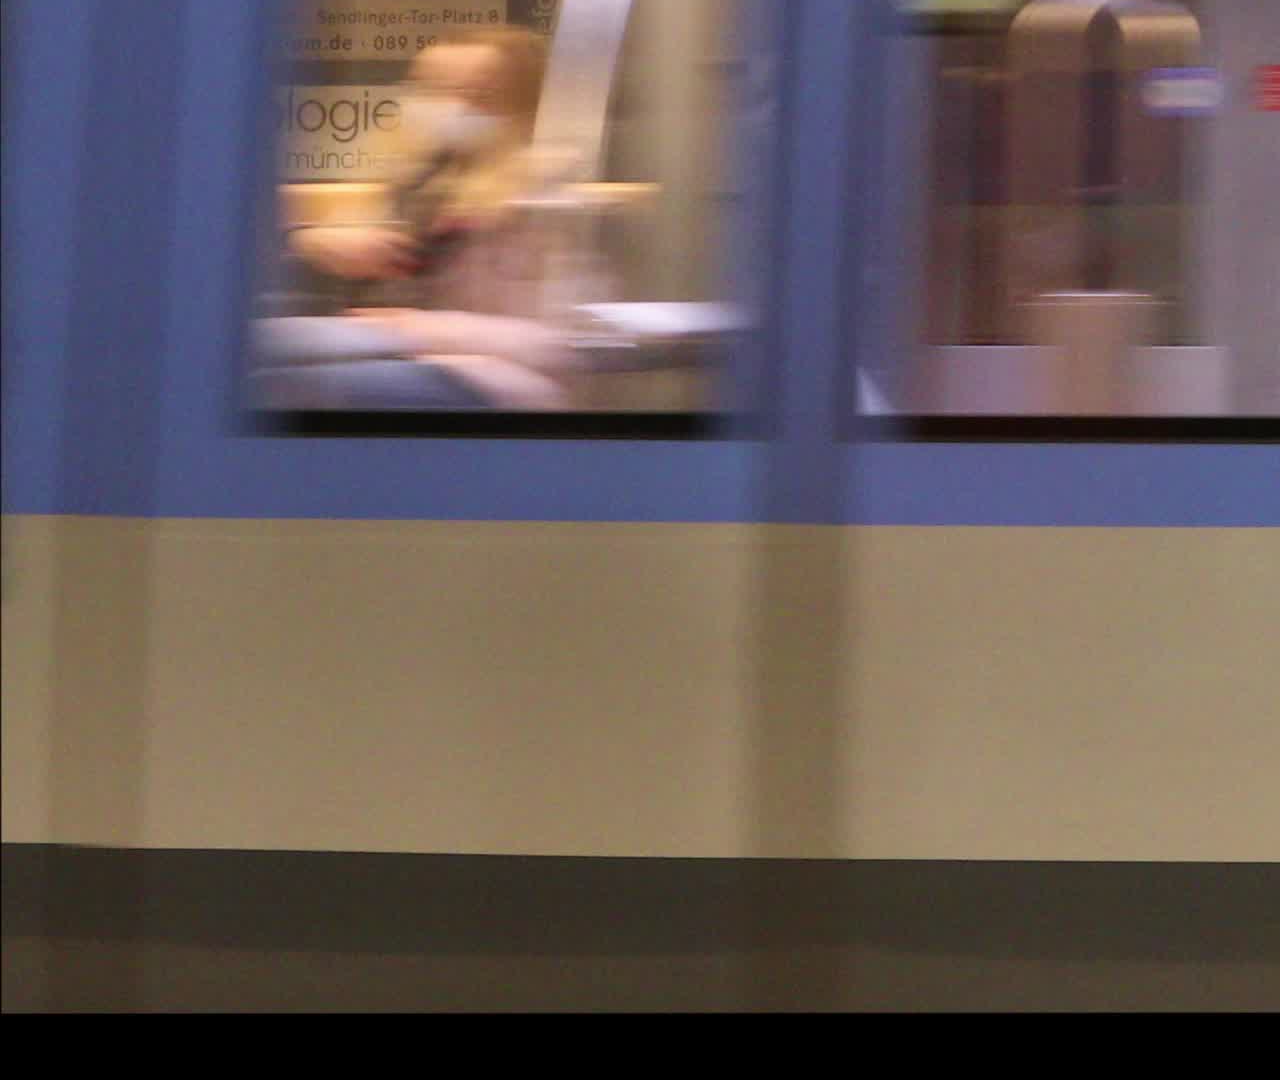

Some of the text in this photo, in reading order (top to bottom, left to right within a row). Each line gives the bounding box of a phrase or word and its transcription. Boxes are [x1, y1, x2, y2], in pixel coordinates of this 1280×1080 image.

[316, 8, 483, 27] Sendlinger-Tor-Platz
[373, 34, 409, 50] 089
[282, 82, 401, 143] logie
